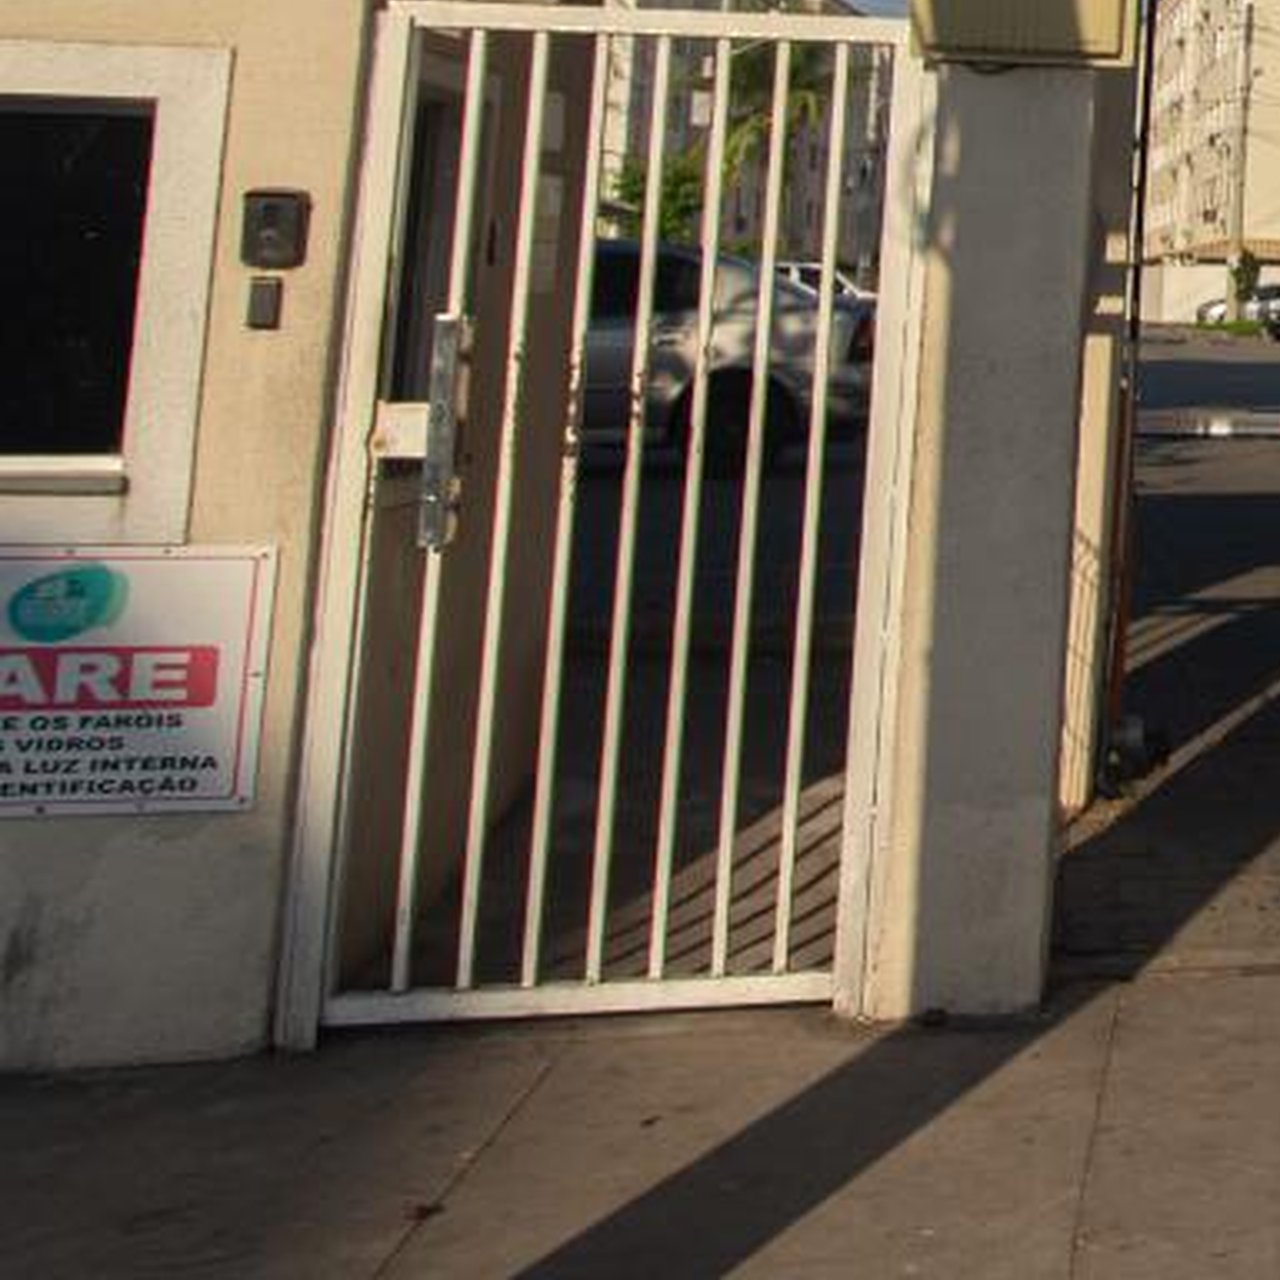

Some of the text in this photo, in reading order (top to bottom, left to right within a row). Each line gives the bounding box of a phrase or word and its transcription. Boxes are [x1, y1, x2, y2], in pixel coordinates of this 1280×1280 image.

[29, 715, 69, 730] OS
[15, 736, 125, 753] VIDROS
[24, 758, 80, 775] LUZ
[90, 754, 218, 771] INTERNA
